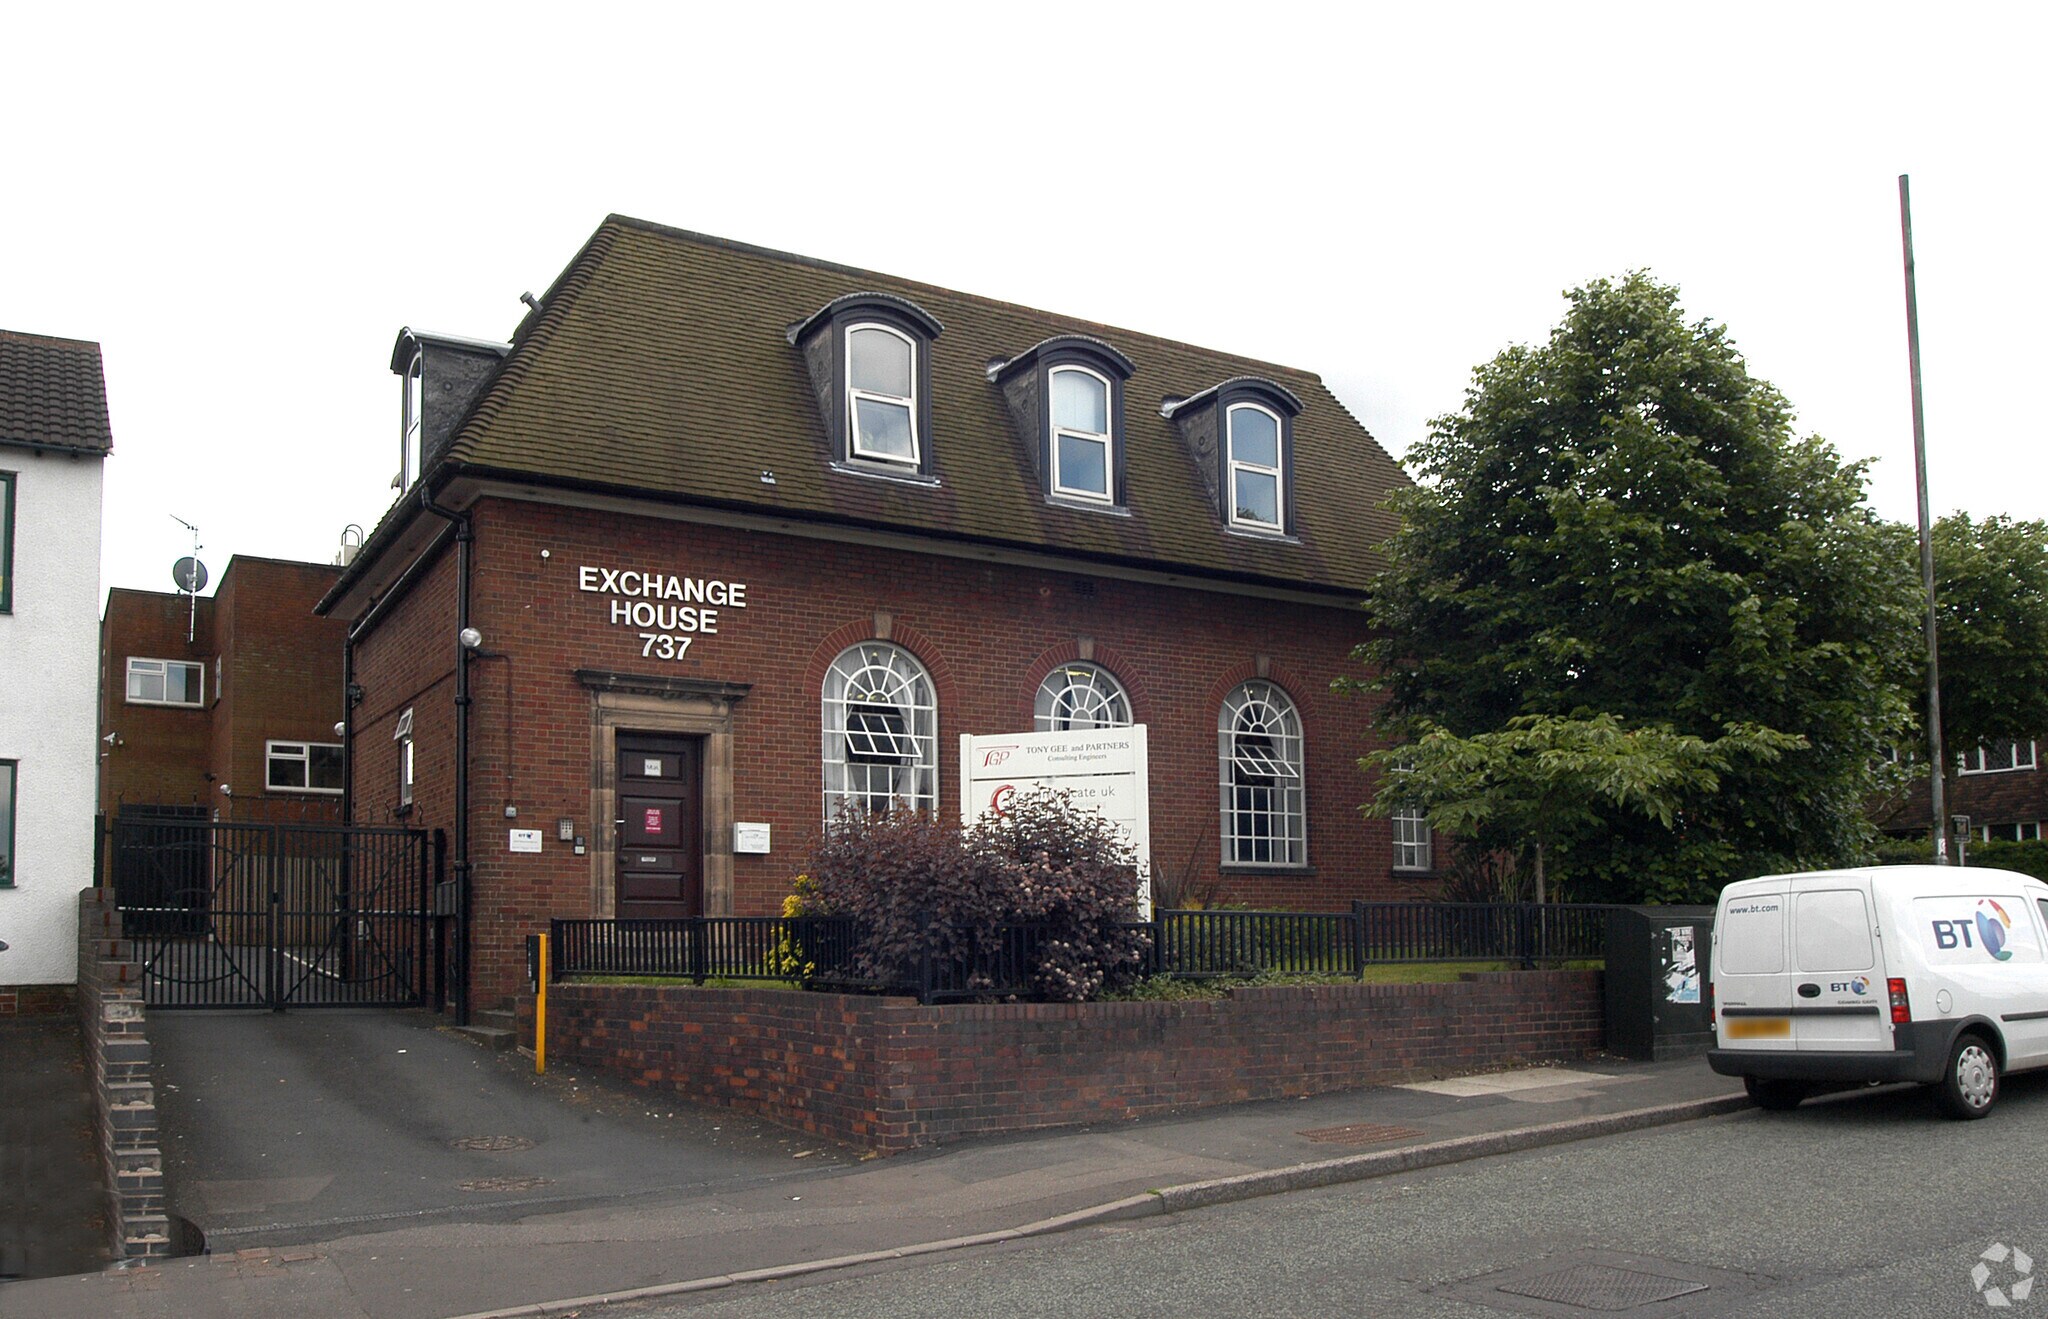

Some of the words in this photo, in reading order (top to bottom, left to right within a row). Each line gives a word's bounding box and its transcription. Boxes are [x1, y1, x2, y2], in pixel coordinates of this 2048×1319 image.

[579, 565, 747, 608] EXCHANGE
[610, 599, 718, 634] HOUSE
[639, 632, 693, 661] 737
[1026, 746, 1049, 754] TONY
[1050, 745, 1067, 753] GEE
[1085, 742, 1130, 751] PARTNERS
[1047, 754, 1078, 762] Consulting
[1078, 753, 1107, 761] Engineers
[1101, 785, 1116, 798] uk
[1121, 824, 1133, 836] by
[1729, 904, 1779, 914] www.bt.com
[1931, 919, 1974, 950] BT
[1830, 982, 1850, 992] BT
